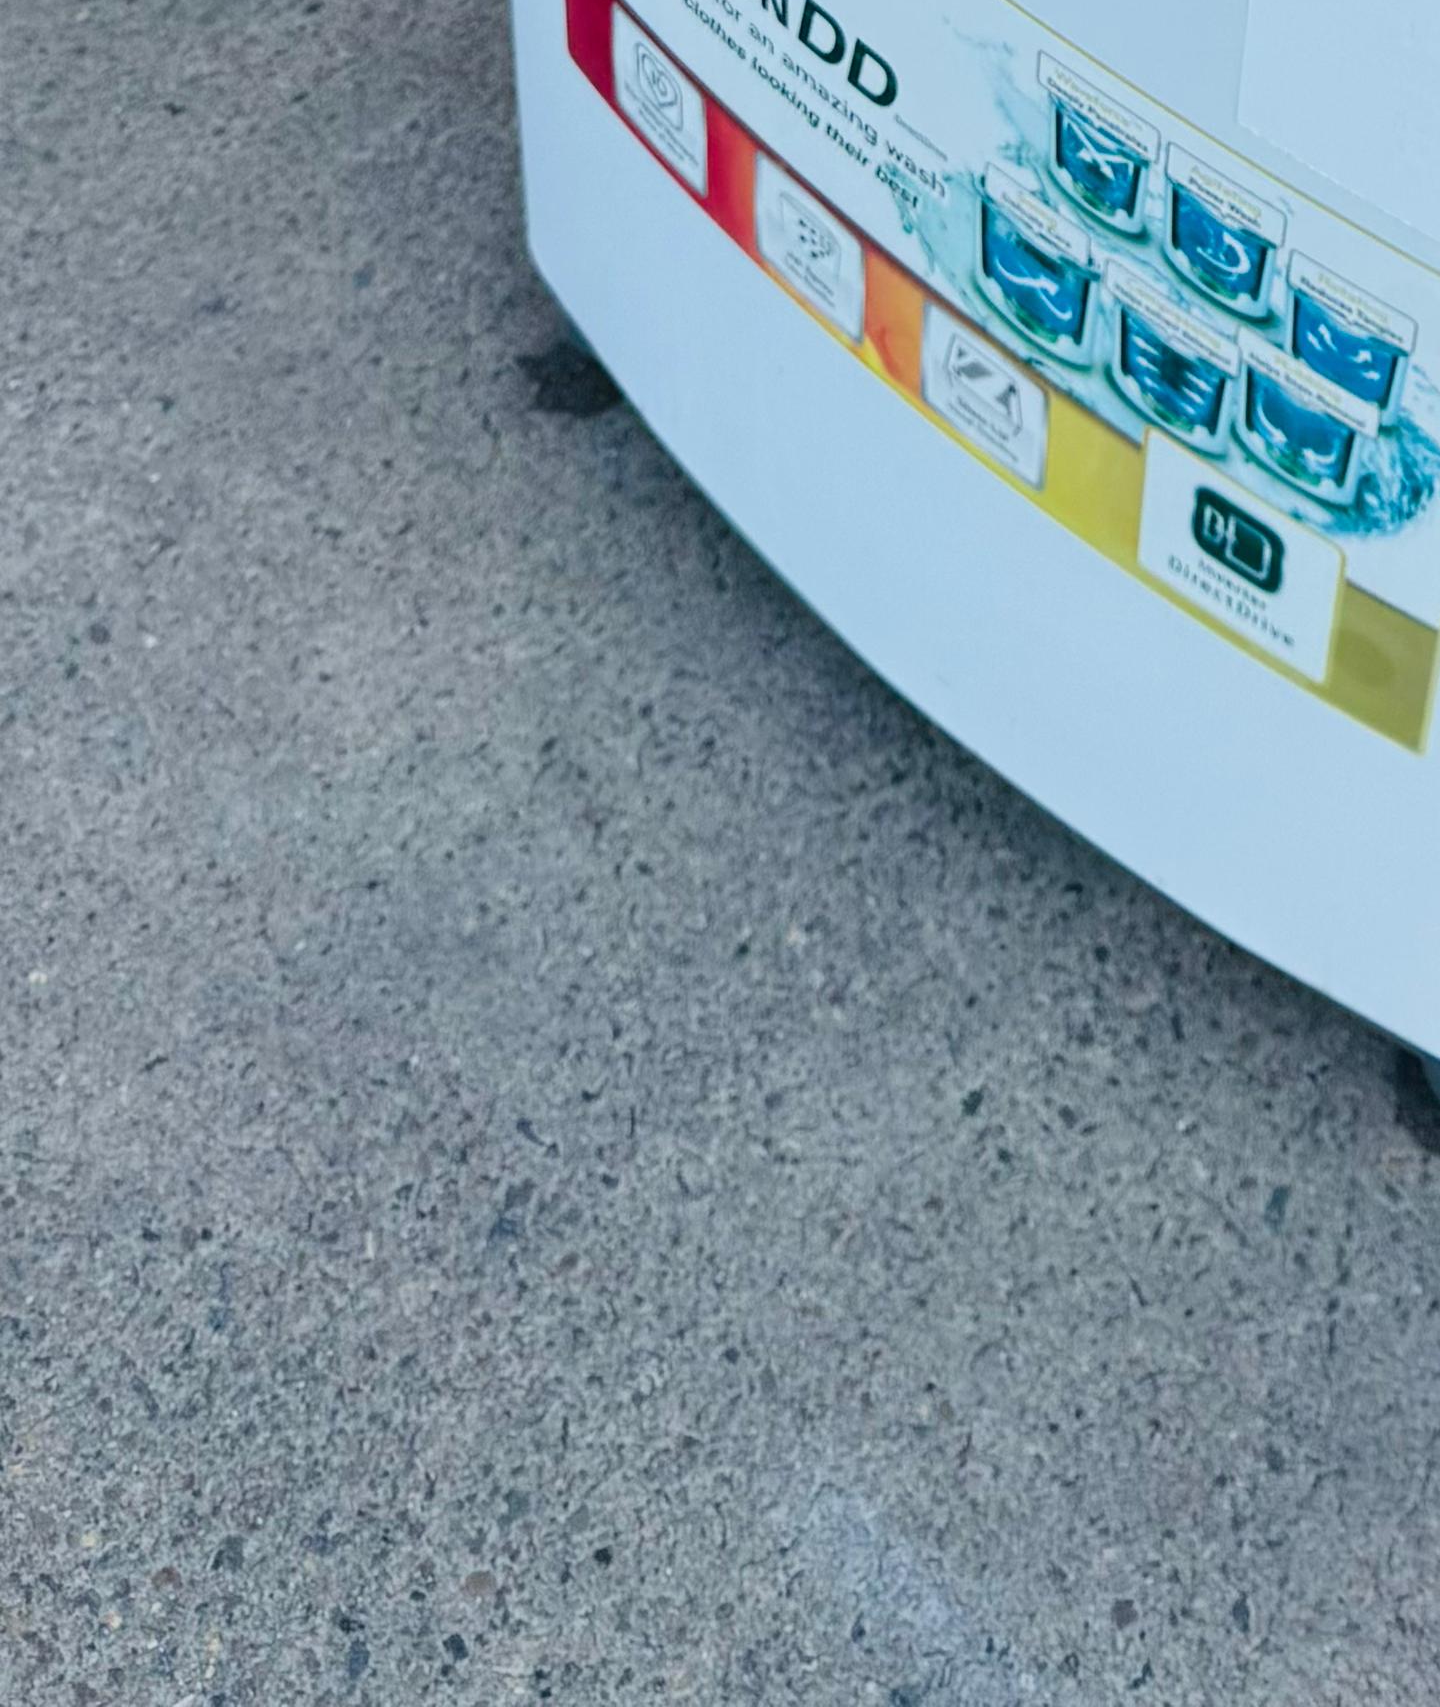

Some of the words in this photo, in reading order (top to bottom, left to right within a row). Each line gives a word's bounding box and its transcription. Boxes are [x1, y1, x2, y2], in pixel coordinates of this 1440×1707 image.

[748, 21, 776, 56] an
[781, 52, 879, 147] amazing
[884, 139, 947, 199] wash
[751, 56, 821, 129] looking
[825, 122, 870, 168] their
[874, 163, 919, 209] best
